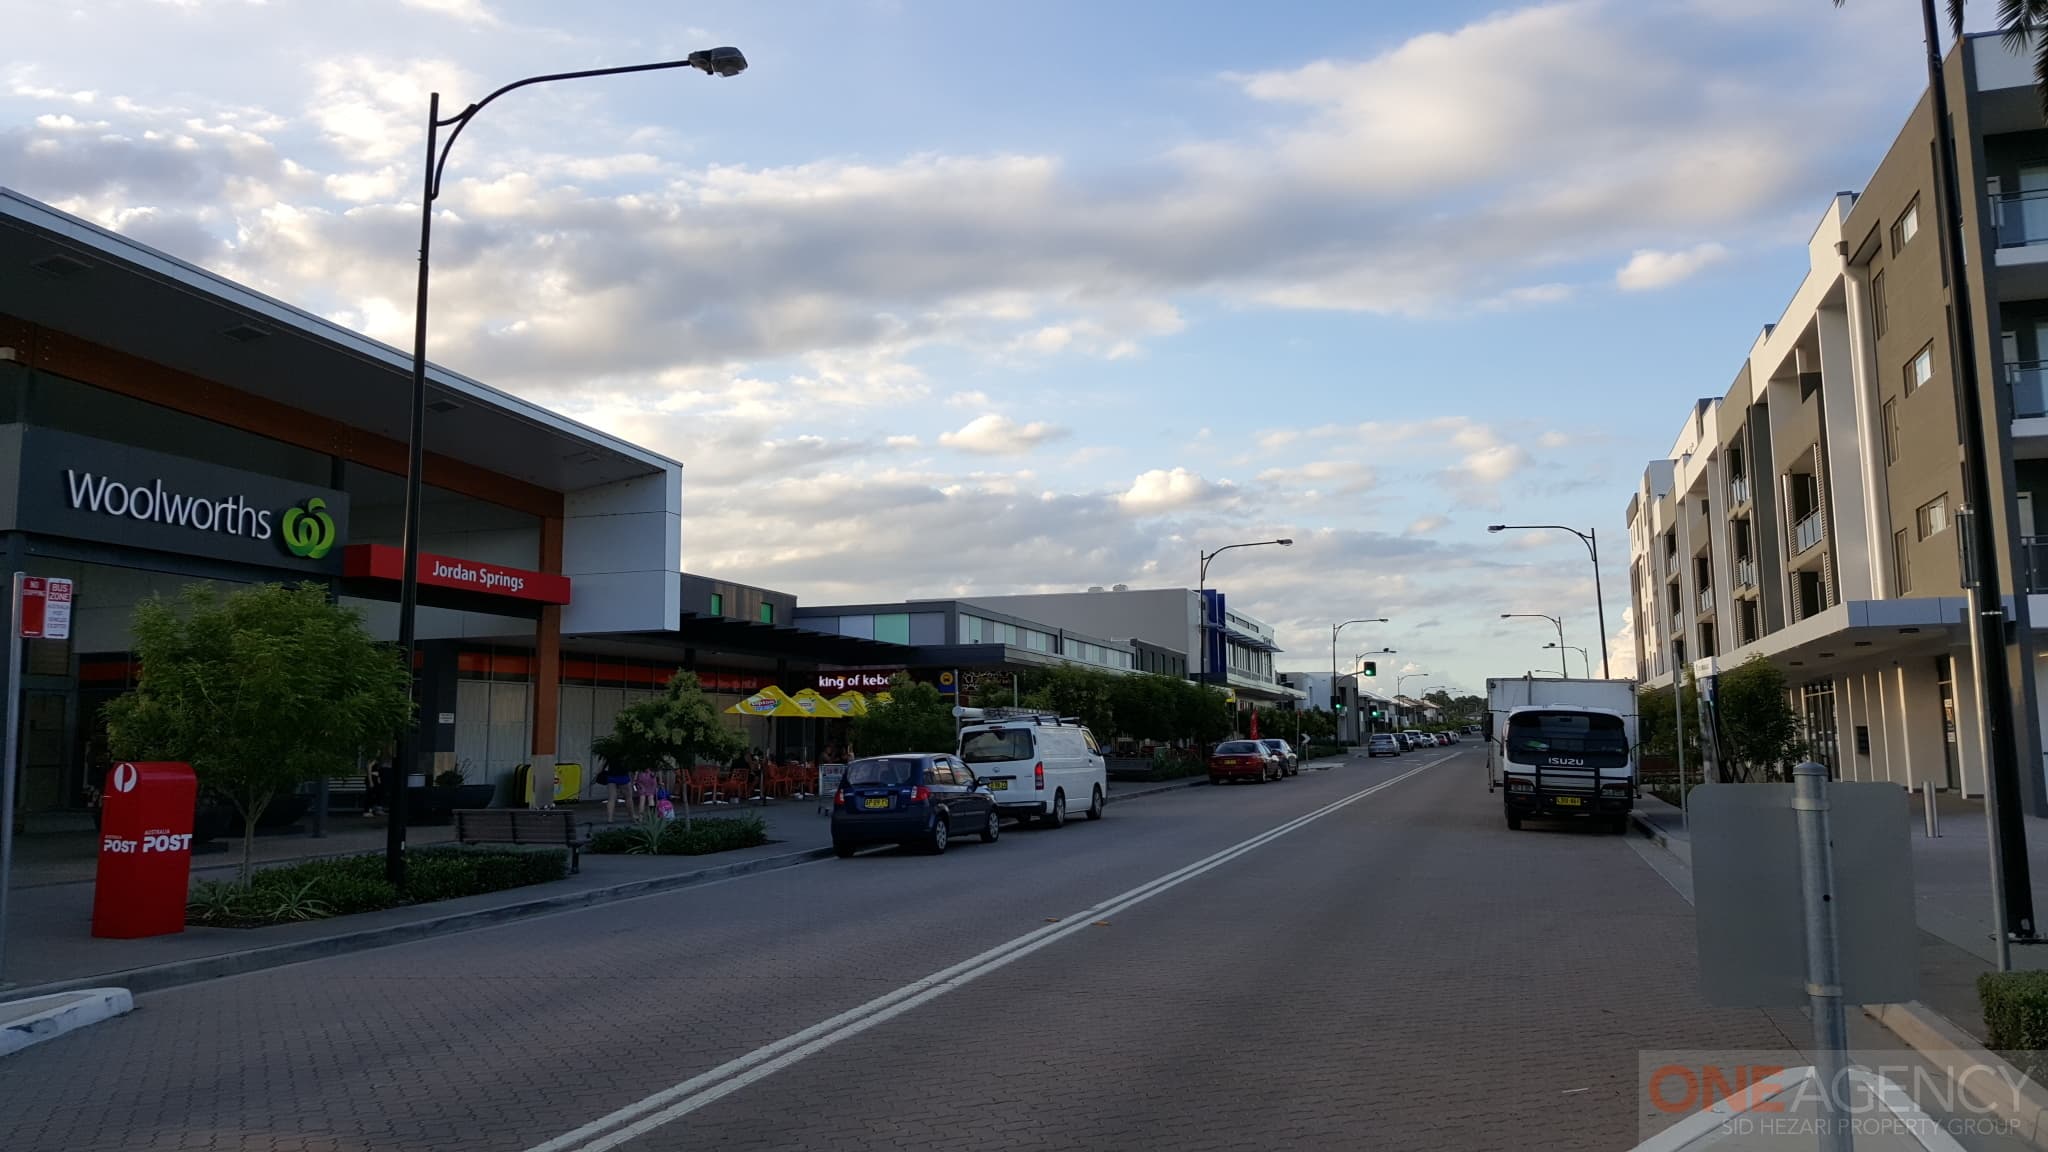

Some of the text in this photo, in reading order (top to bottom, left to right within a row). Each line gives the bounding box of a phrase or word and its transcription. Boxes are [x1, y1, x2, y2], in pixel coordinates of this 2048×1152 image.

[68, 469, 272, 540] Woolworths
[433, 560, 524, 592] Jordan Springs
[52, 583, 69, 592] BUS
[49, 592, 70, 601] ZONE
[818, 675, 844, 689] king
[847, 674, 860, 686] of
[1548, 757, 1584, 766] ISUZU
[103, 839, 138, 854] POST
[143, 833, 192, 853] POST
